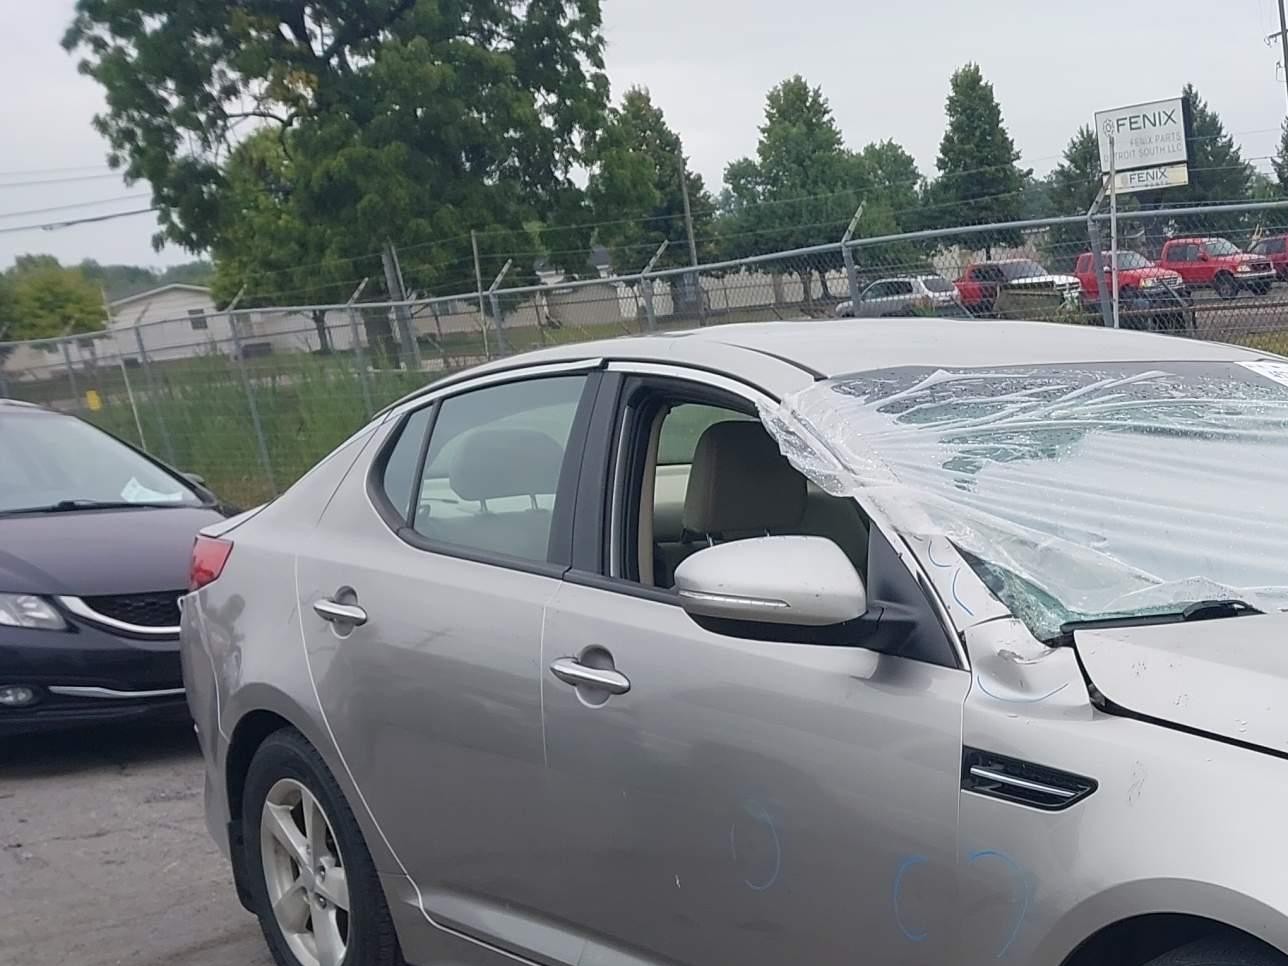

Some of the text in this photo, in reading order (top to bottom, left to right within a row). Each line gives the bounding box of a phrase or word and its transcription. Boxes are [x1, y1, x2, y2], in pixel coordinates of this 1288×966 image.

[1116, 108, 1177, 133] FENIX
[1138, 146, 1166, 158] SOUTH
[1167, 142, 1183, 154] LLC
[1129, 168, 1168, 184] FENIX
